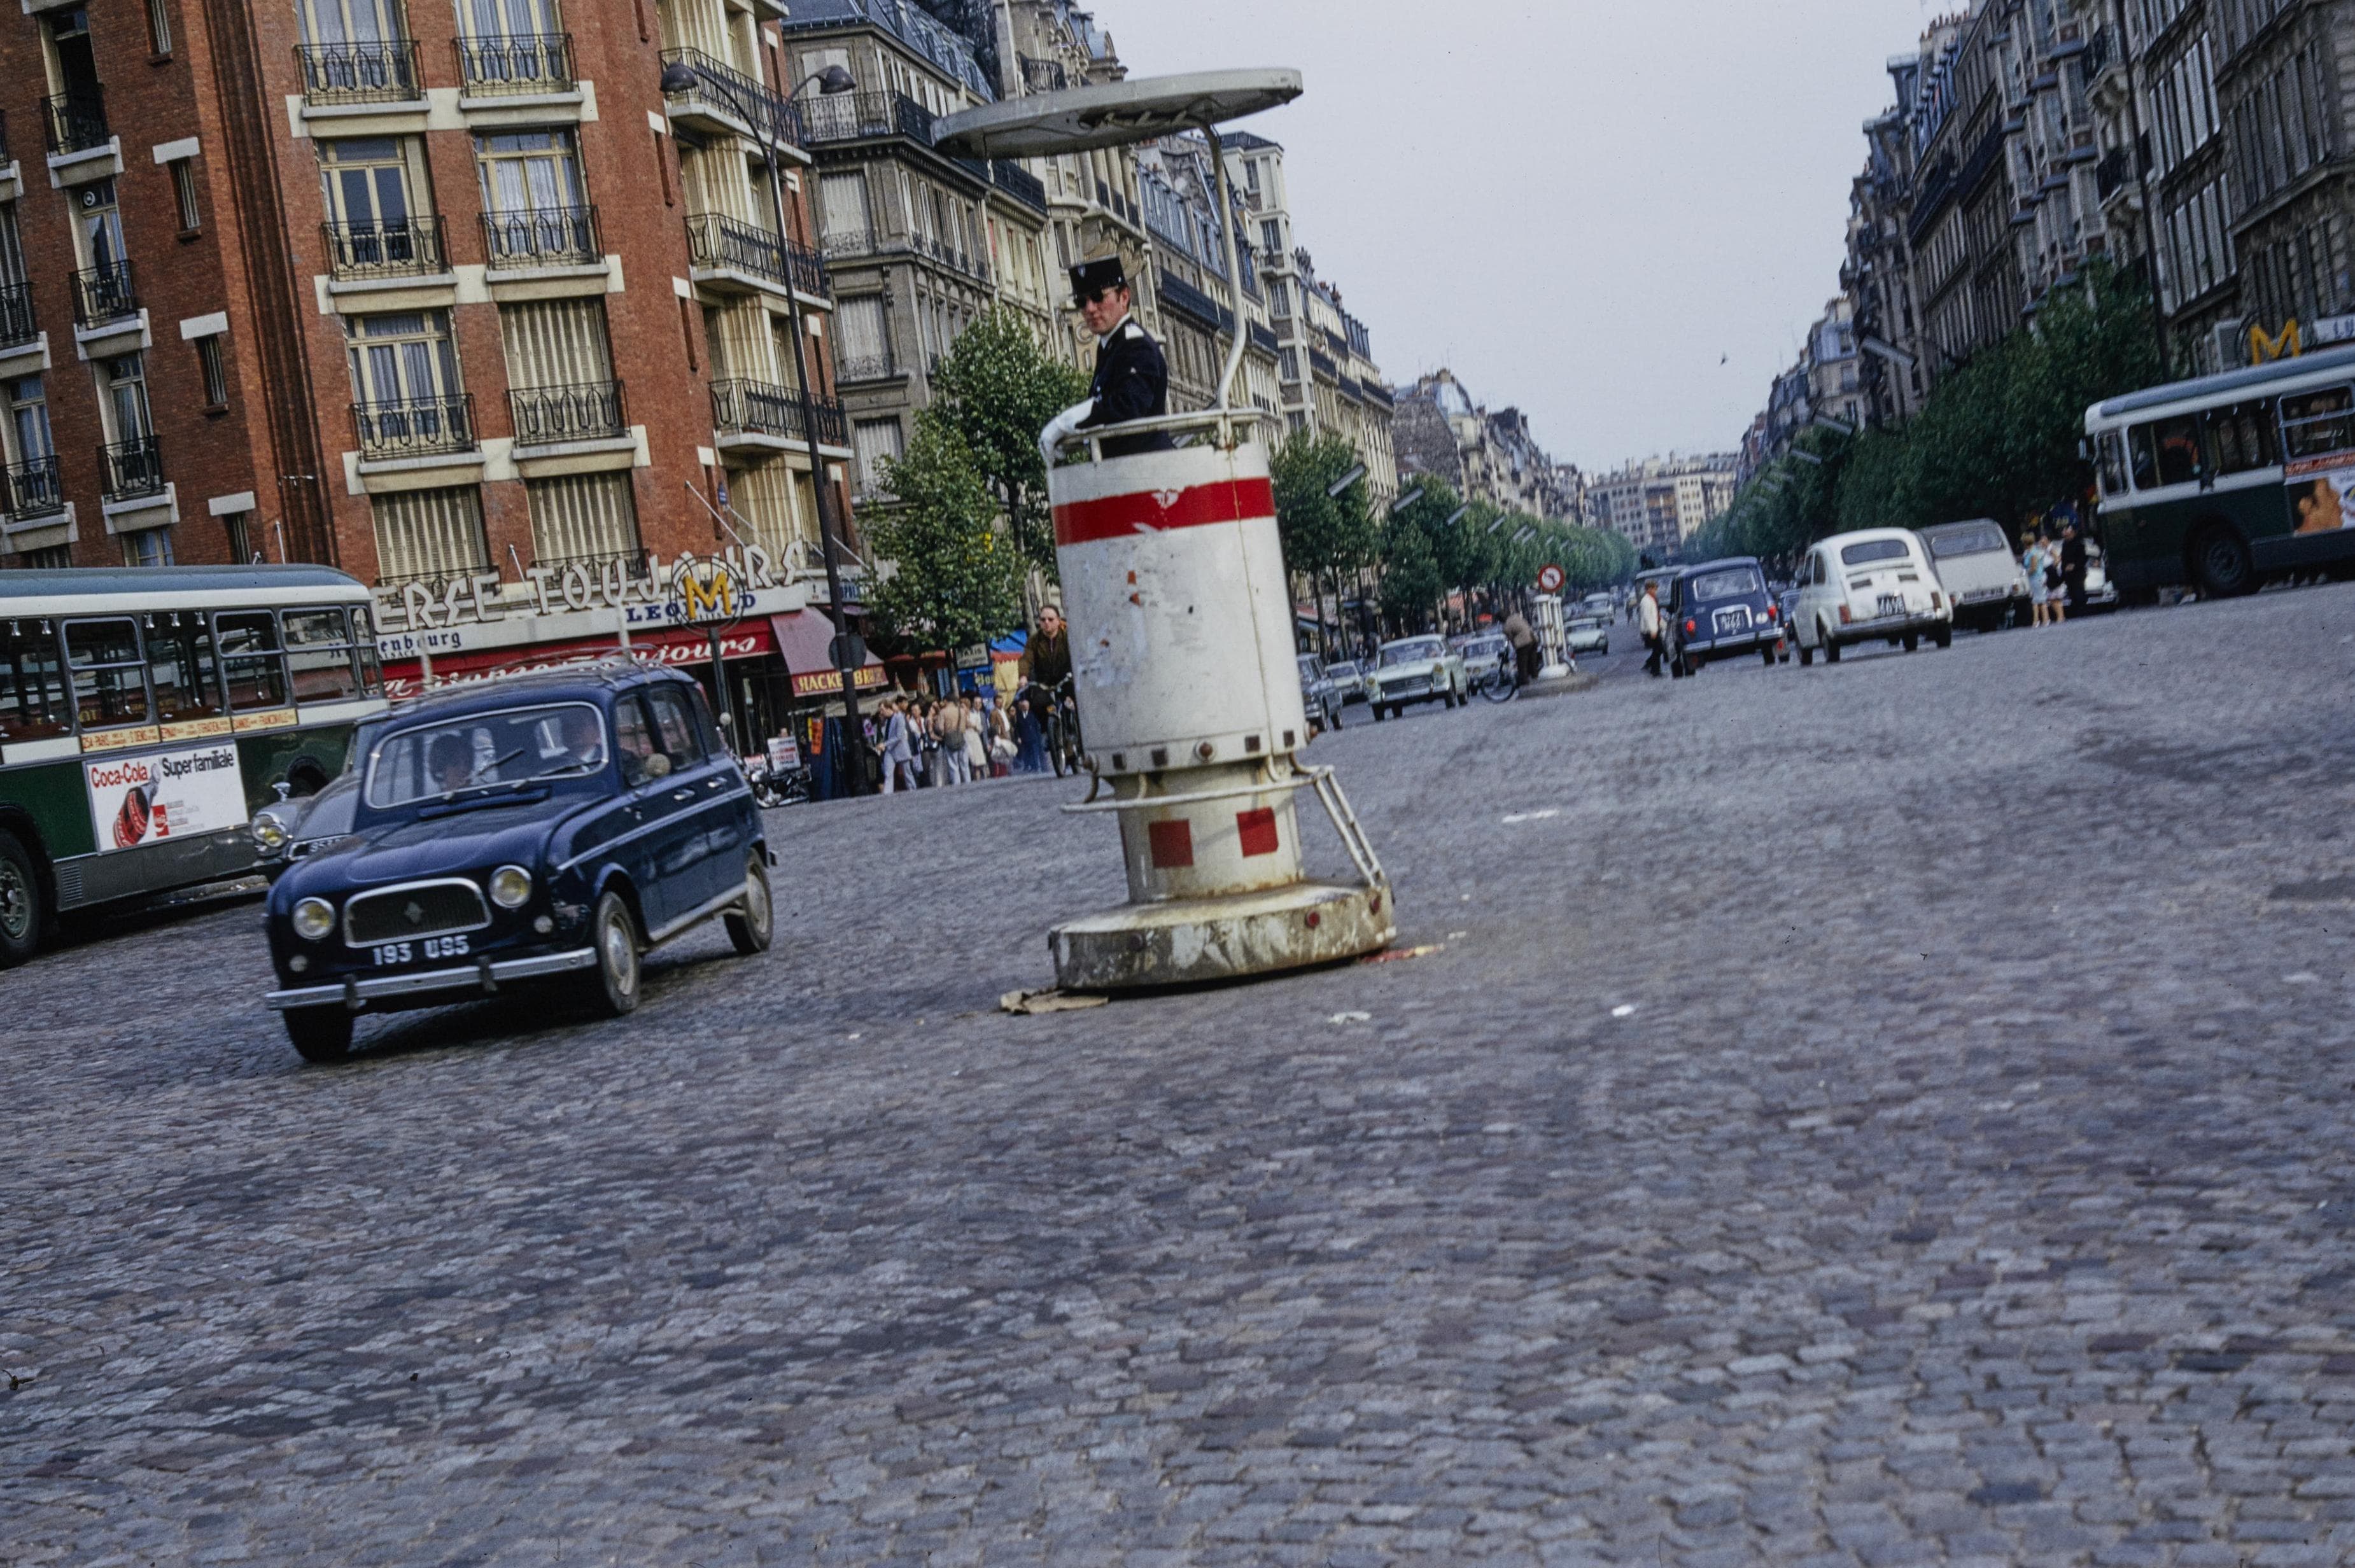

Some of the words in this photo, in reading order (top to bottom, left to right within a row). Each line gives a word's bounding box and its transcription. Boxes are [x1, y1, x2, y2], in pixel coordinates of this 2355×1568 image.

[2250, 317, 2301, 367] M
[526, 538, 804, 615] TOUJOURS
[683, 571, 732, 620] M
[626, 594, 756, 622] LEOPOD
[91, 762, 148, 788] Coca-Cola
